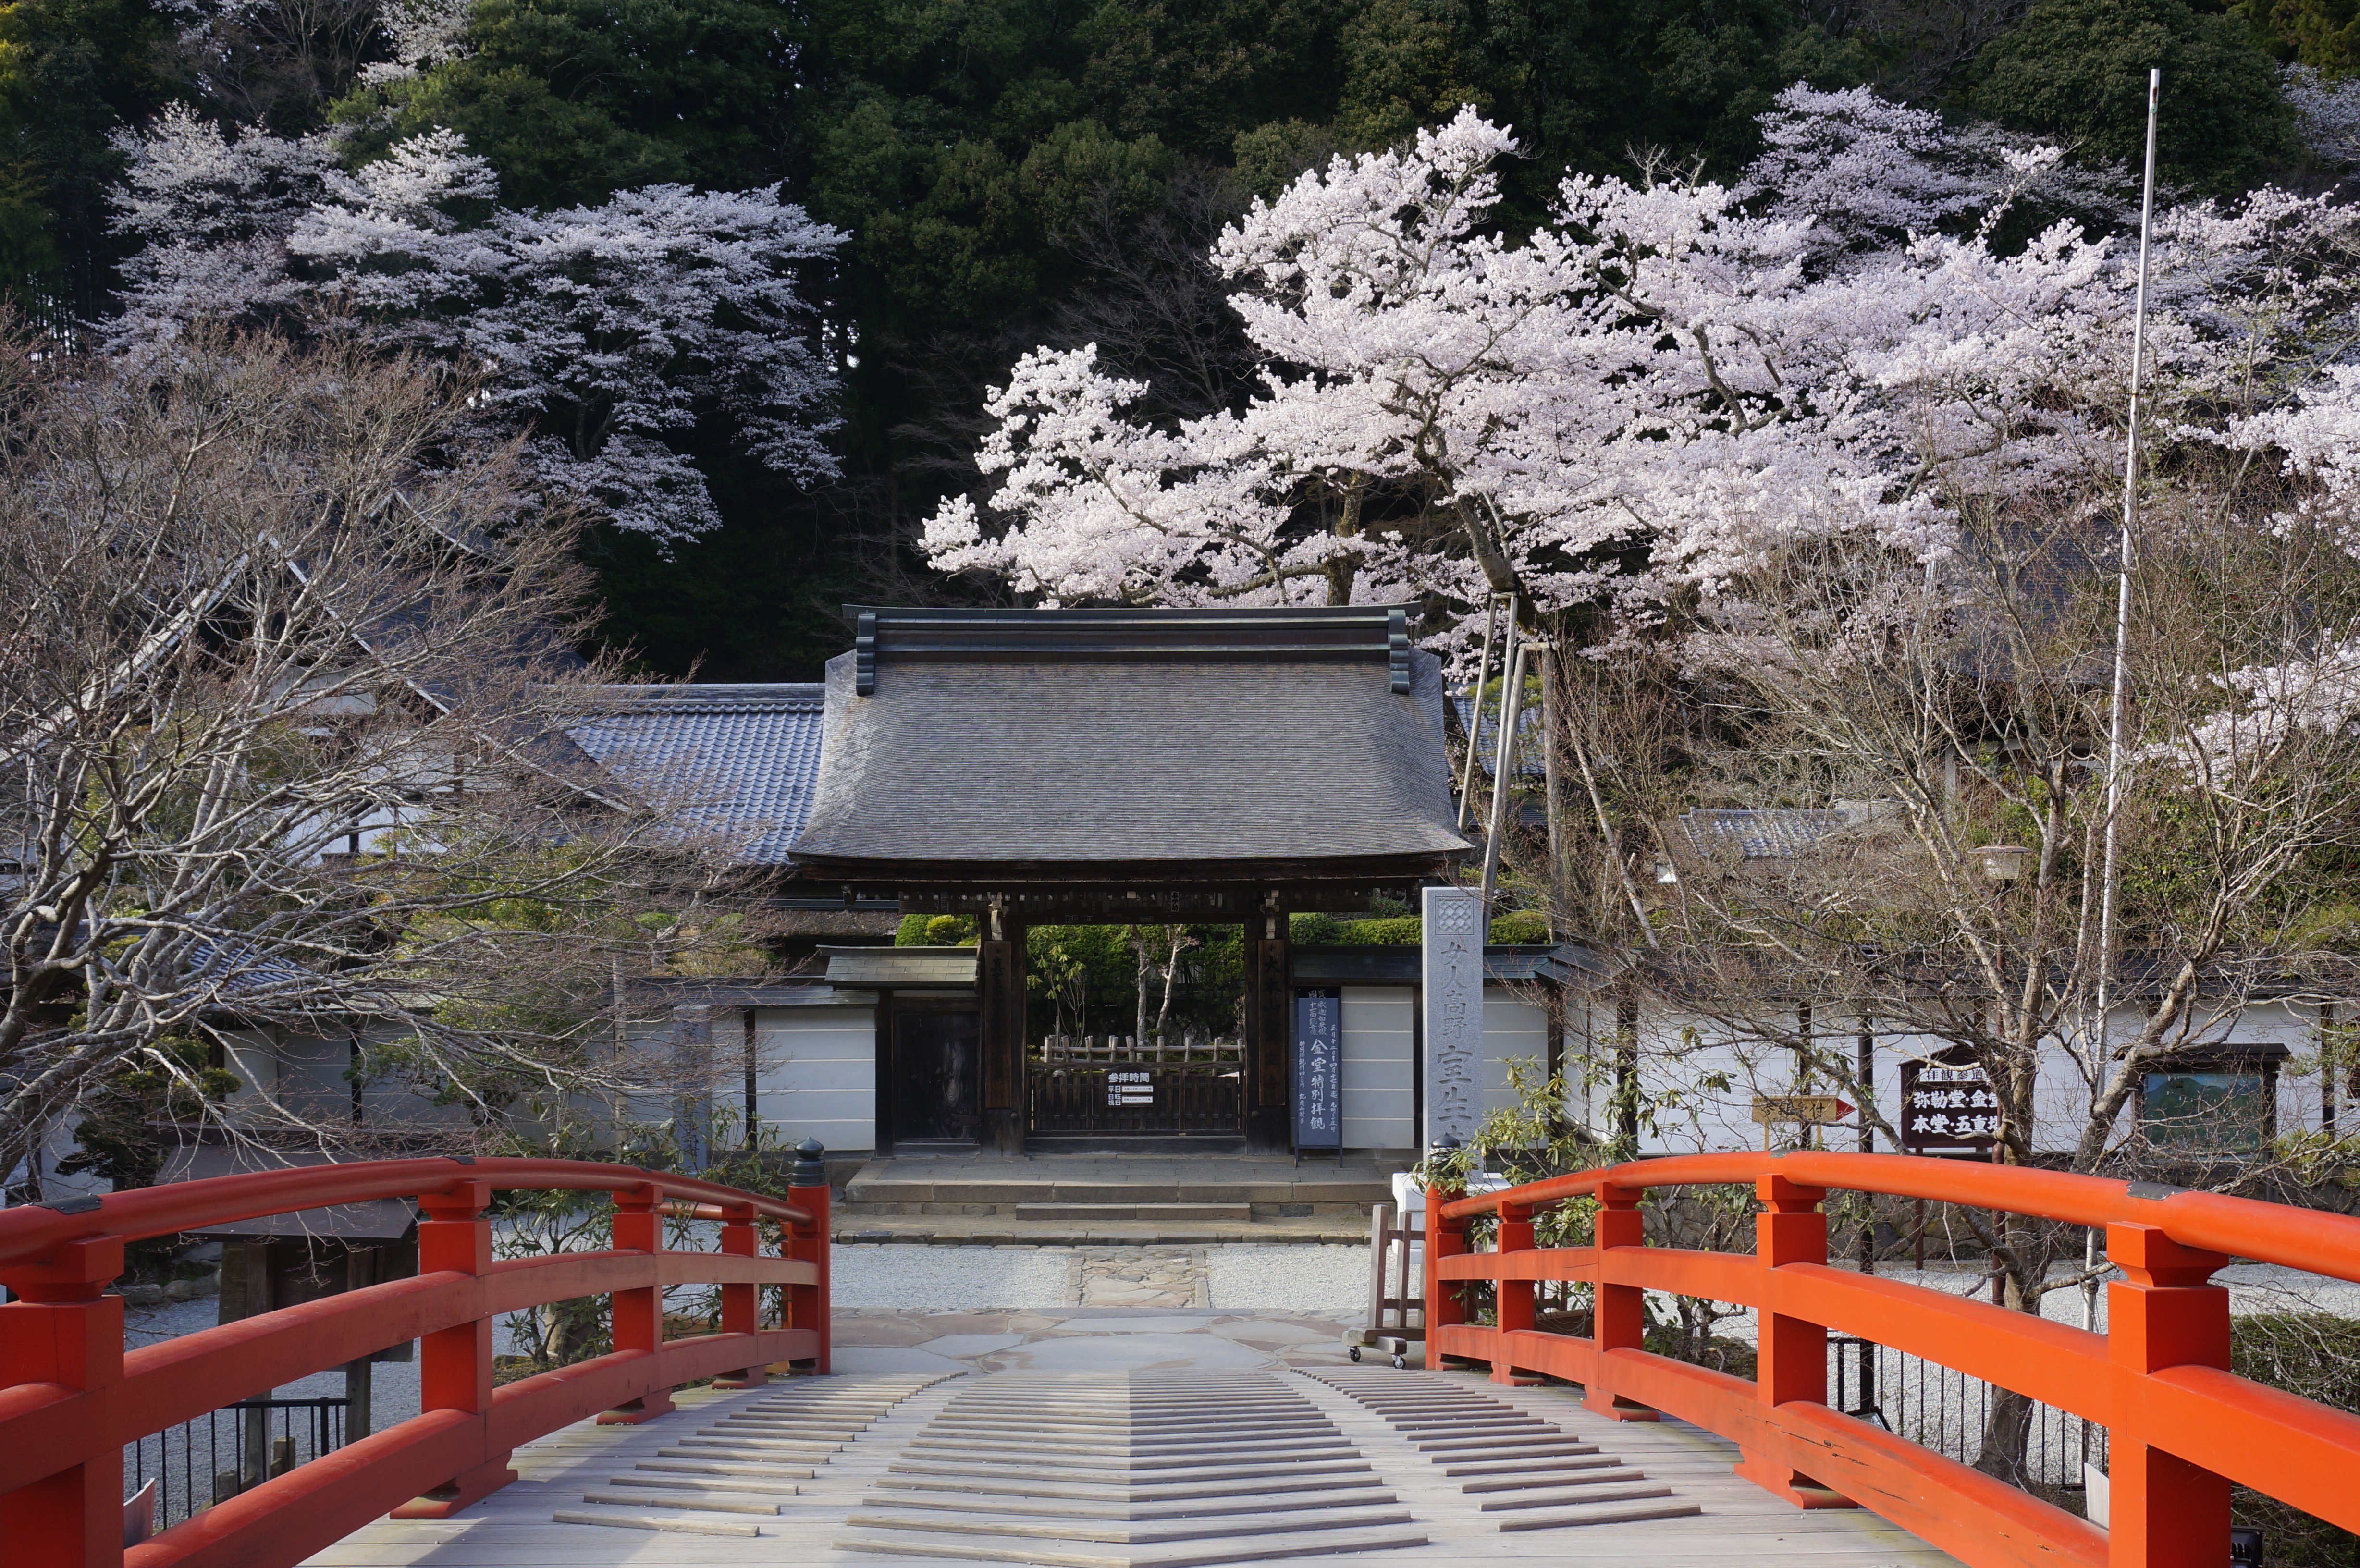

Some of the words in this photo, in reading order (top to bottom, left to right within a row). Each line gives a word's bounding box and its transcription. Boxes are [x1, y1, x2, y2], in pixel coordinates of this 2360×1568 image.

[1108, 1072, 1150, 1083] 参拝時間
[1310, 1038, 1328, 1130] 金堂特別拝観
